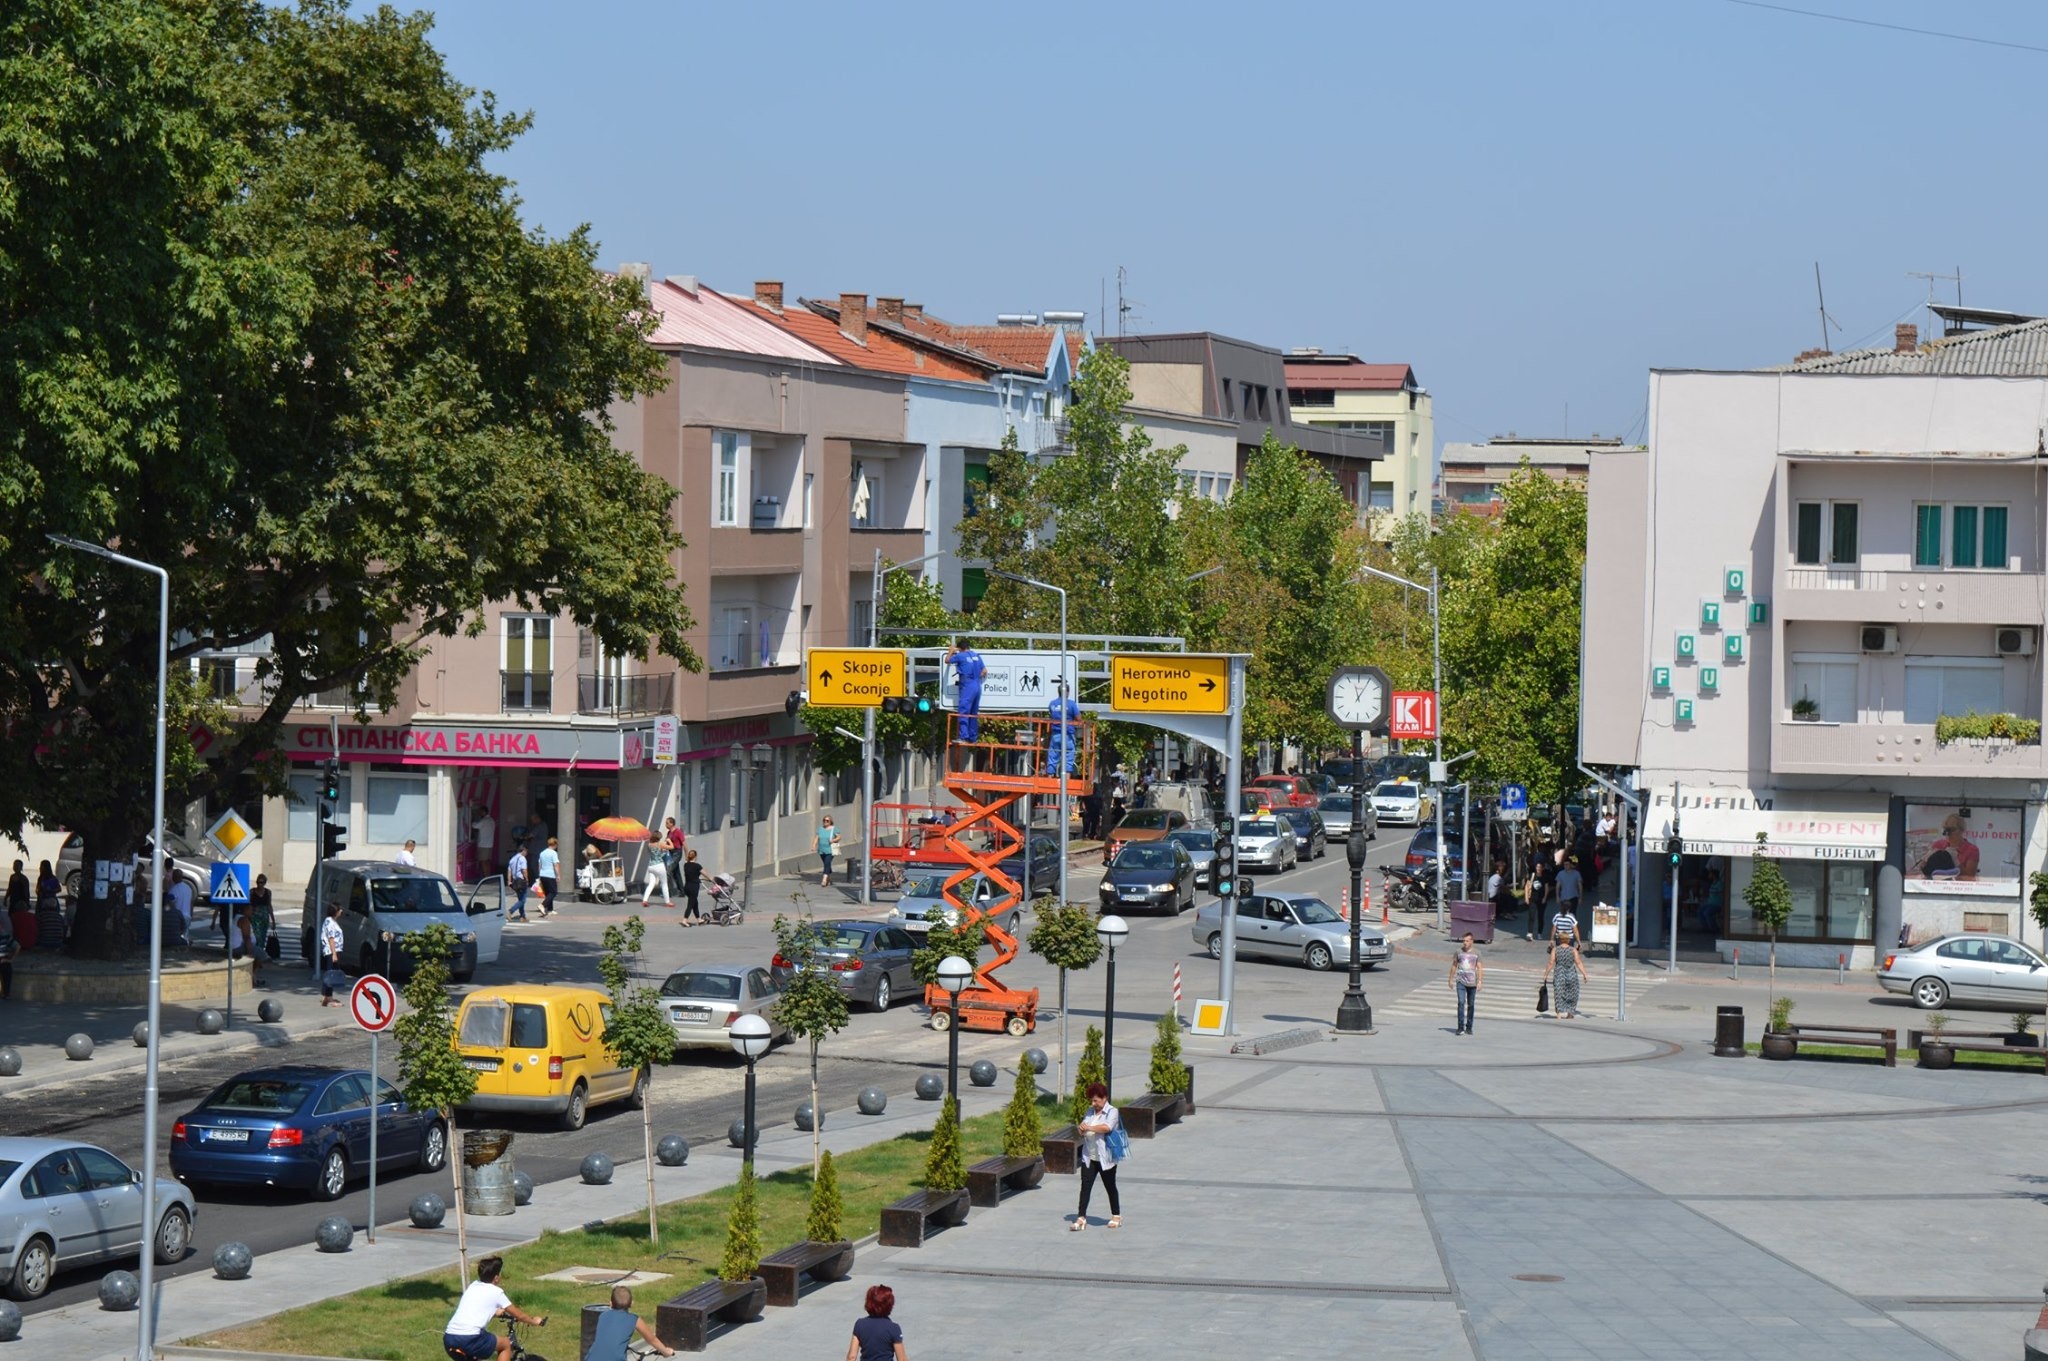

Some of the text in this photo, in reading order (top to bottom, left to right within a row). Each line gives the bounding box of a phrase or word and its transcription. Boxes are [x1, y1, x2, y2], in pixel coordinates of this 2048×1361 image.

[843, 660, 892, 677] Skopje
[1122, 667, 1191, 680] Неготино
[987, 672, 1008, 682] олиција
[843, 682, 891, 697] Скопје
[984, 683, 1008, 692] Police
[1122, 686, 1188, 704] Negotino
[297, 727, 541, 754] СТОПАНСКА БАНКА
[1655, 795, 1774, 811] FUJIFILM
[1965, 831, 2019, 840] FUJI DENT
[1653, 841, 1713, 853] FUFILM
[1814, 847, 1876, 858] FUJIFILM
